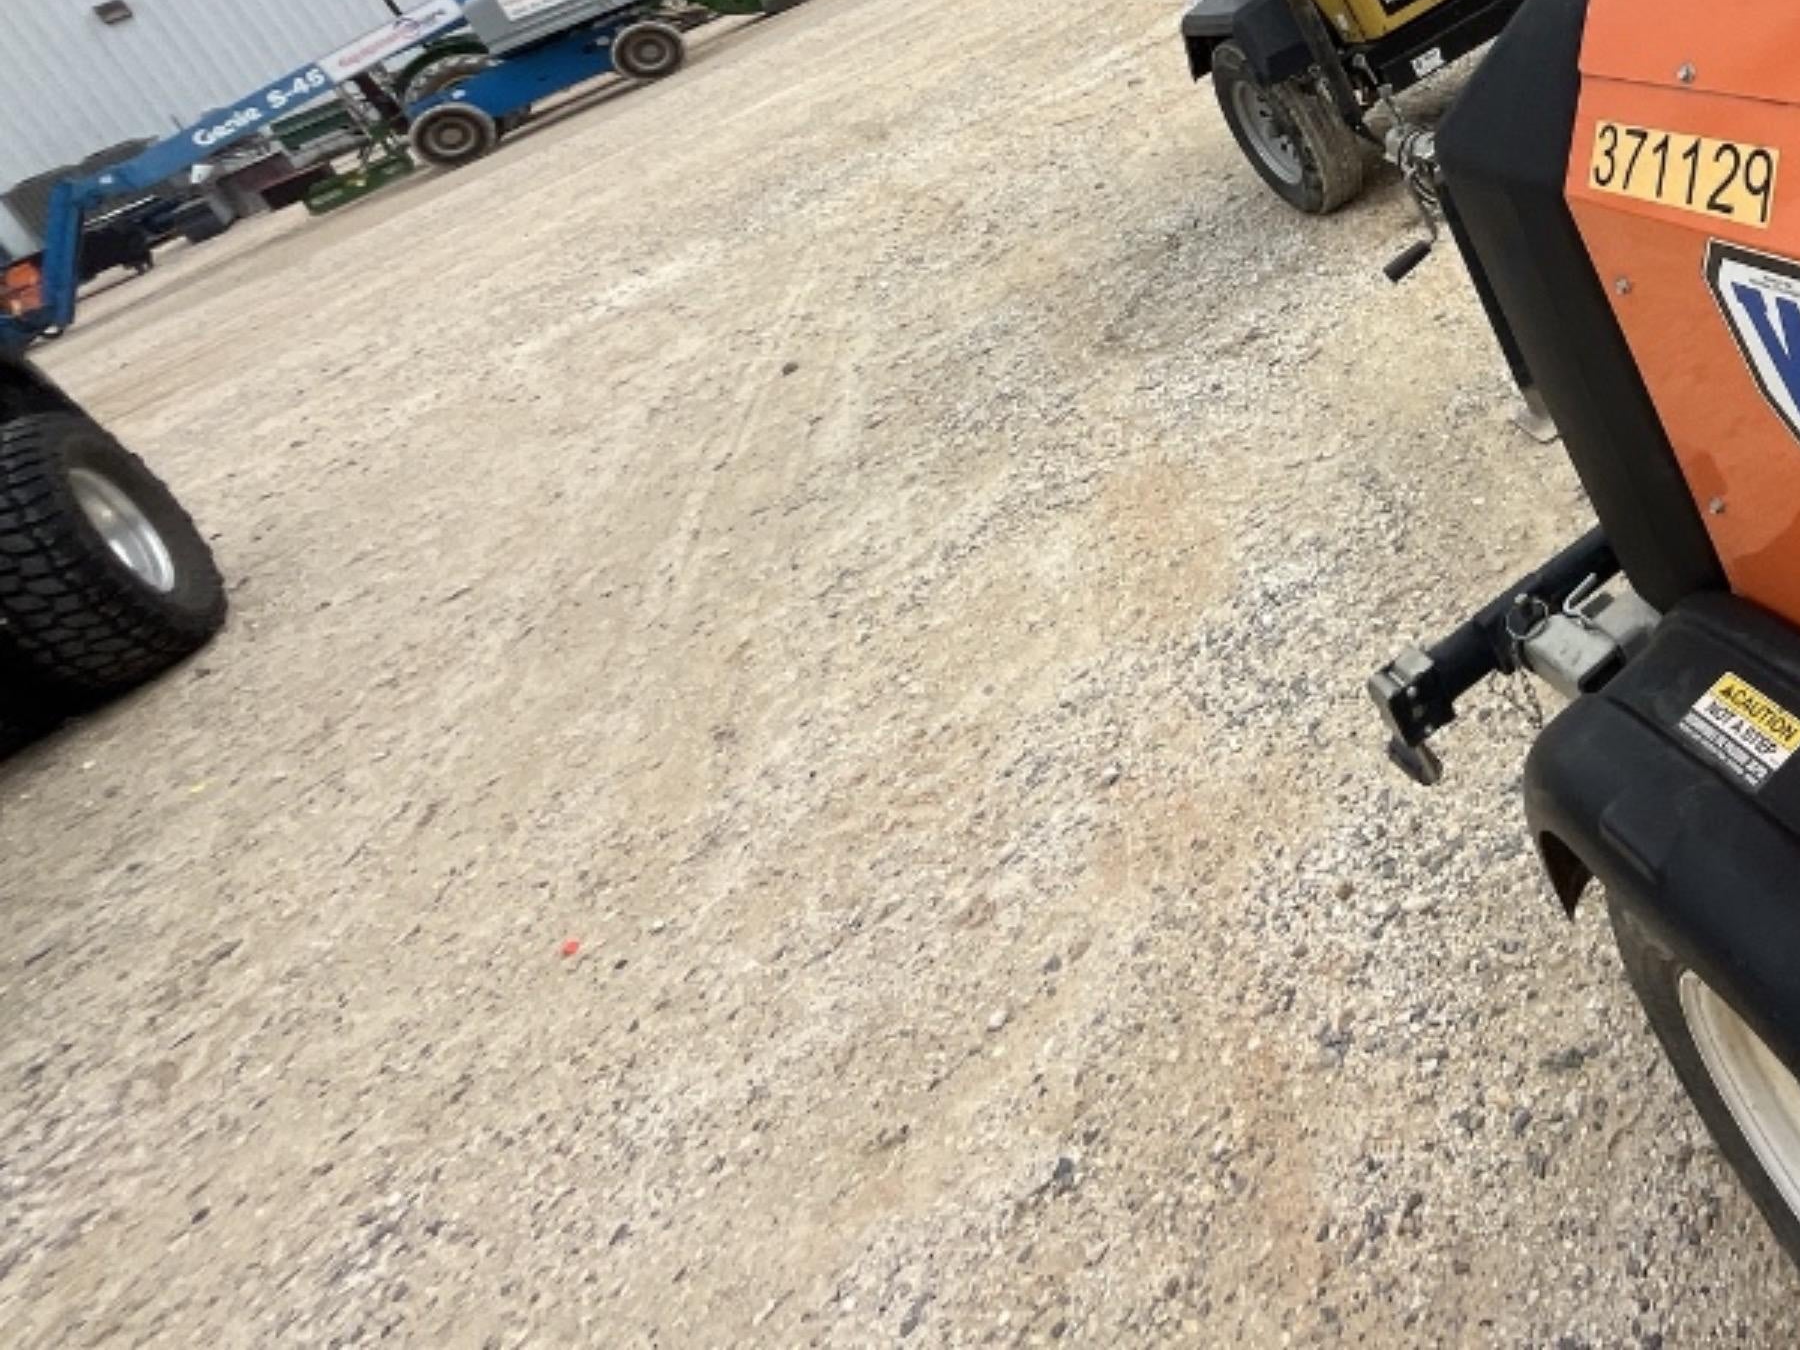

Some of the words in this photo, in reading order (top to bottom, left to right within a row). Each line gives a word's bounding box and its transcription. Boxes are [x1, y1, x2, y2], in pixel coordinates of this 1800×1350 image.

[192, 106, 263, 145] Genie
[266, 68, 325, 109] S-45
[1593, 124, 1775, 223] 371129
[1706, 700, 1734, 726] NOT
[1731, 719, 1744, 733] A
[1731, 688, 1798, 742] CAUTION
